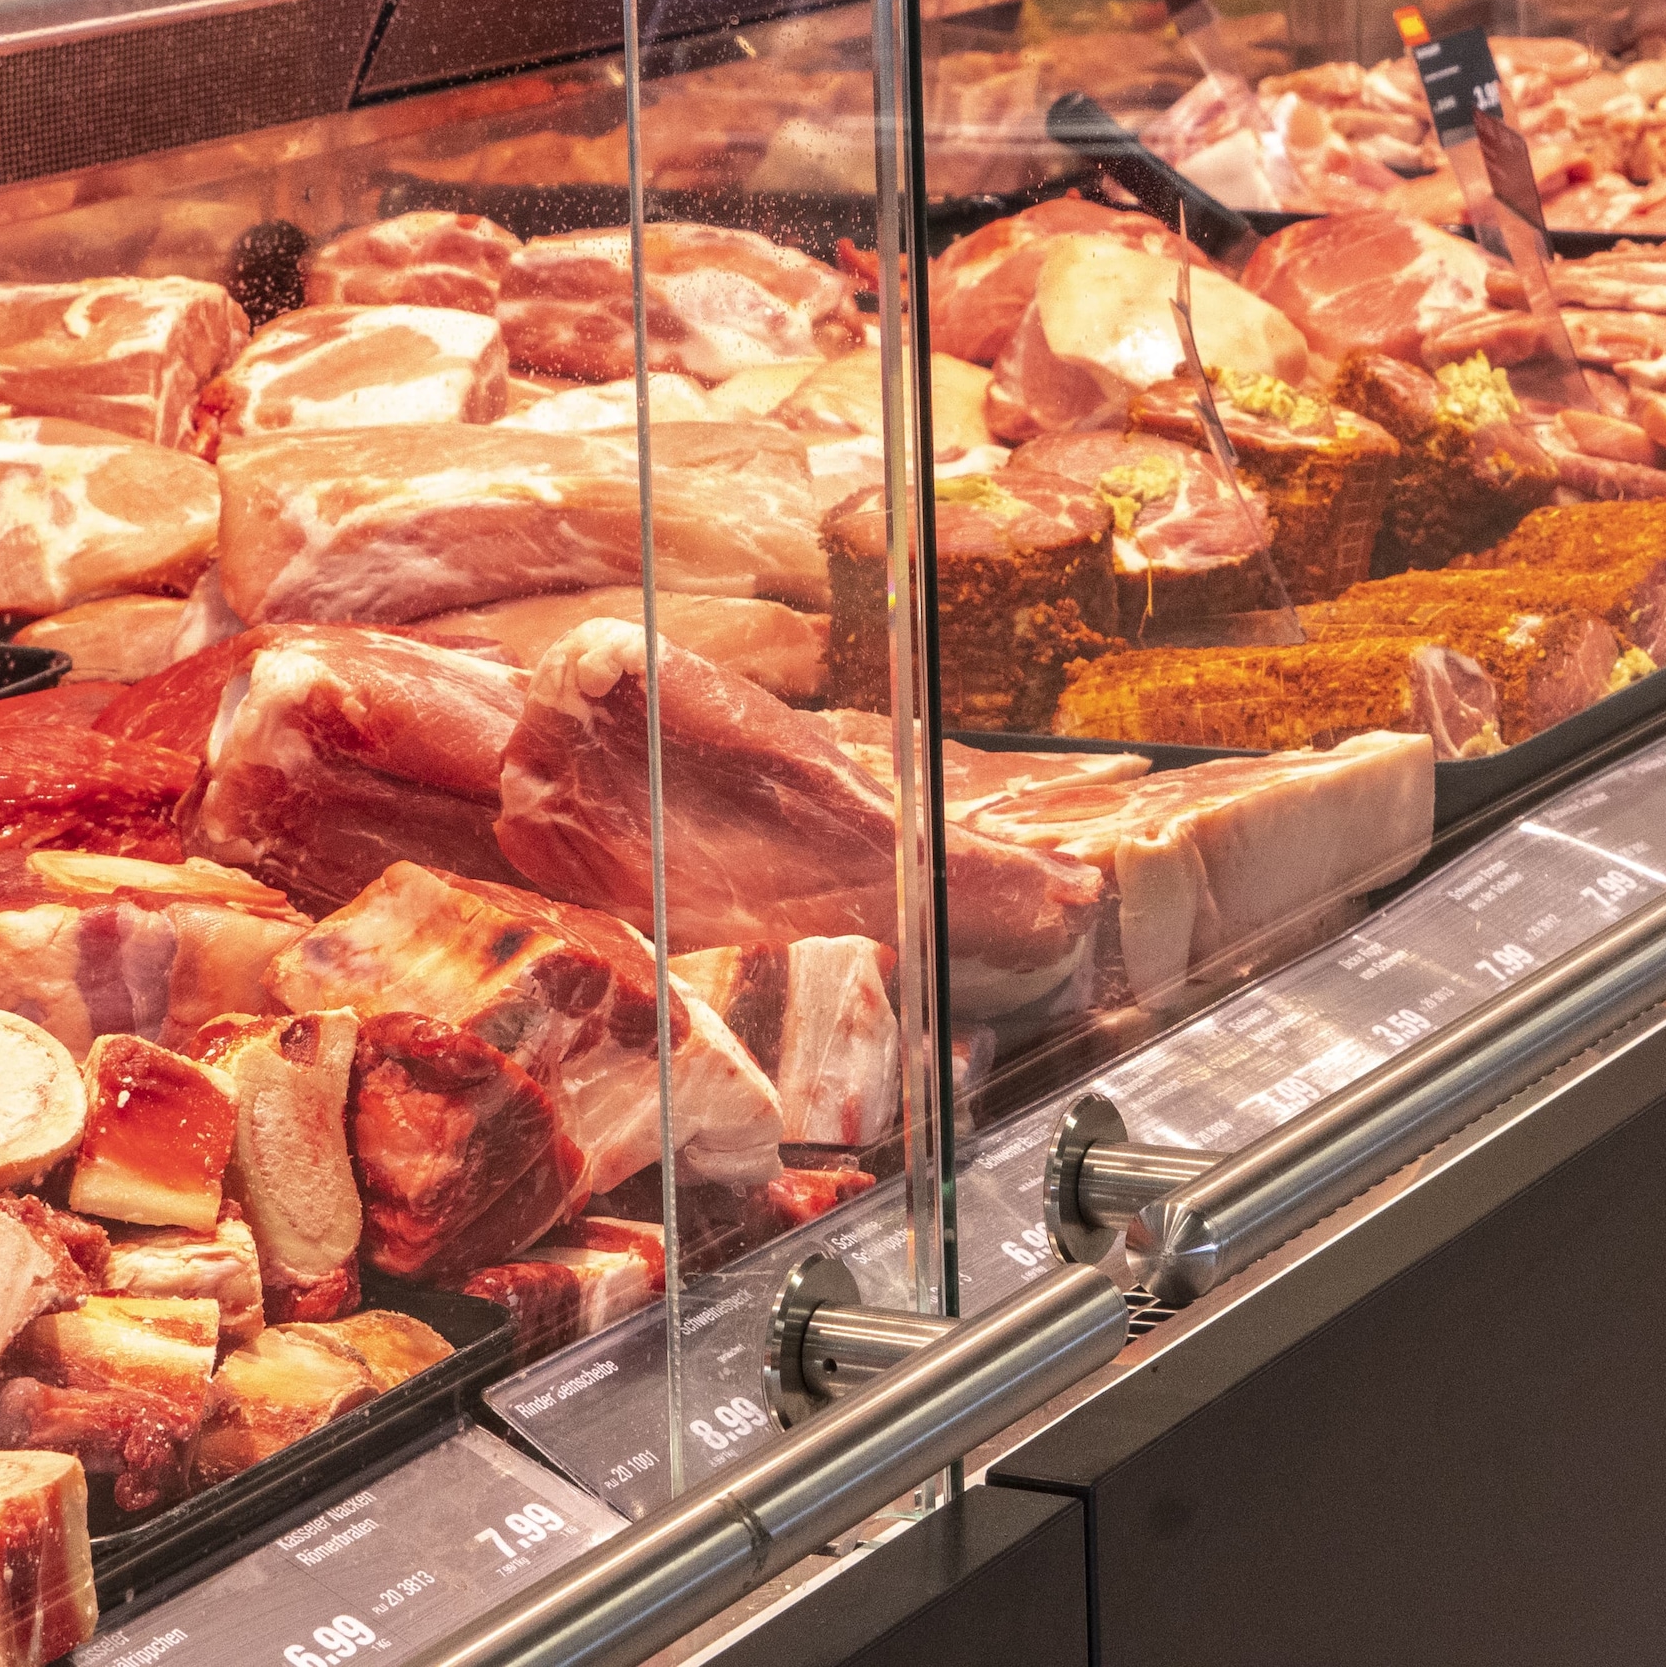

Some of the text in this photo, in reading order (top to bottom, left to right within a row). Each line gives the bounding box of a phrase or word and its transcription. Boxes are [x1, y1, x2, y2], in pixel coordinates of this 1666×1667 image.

[1579, 869, 1638, 908] 7.99
[1474, 943, 1535, 982] 7.99
[1371, 1008, 1432, 1046] 3.59
[976, 1139, 1027, 1170] Schweine
[513, 1385, 556, 1419] Rinder
[689, 1396, 769, 1451] 8.99
[610, 1464, 634, 1484] 20
[276, 1490, 378, 1552] Kasseler Nacken
[473, 1502, 567, 1559] 7.99
[294, 1516, 381, 1568] Römerbraten
[371, 1568, 436, 1616] PLU 20 3813
[76, 1630, 130, 1667] asseler
[106, 1627, 189, 1667] älrippchen
[283, 1614, 377, 1667] 6.99
